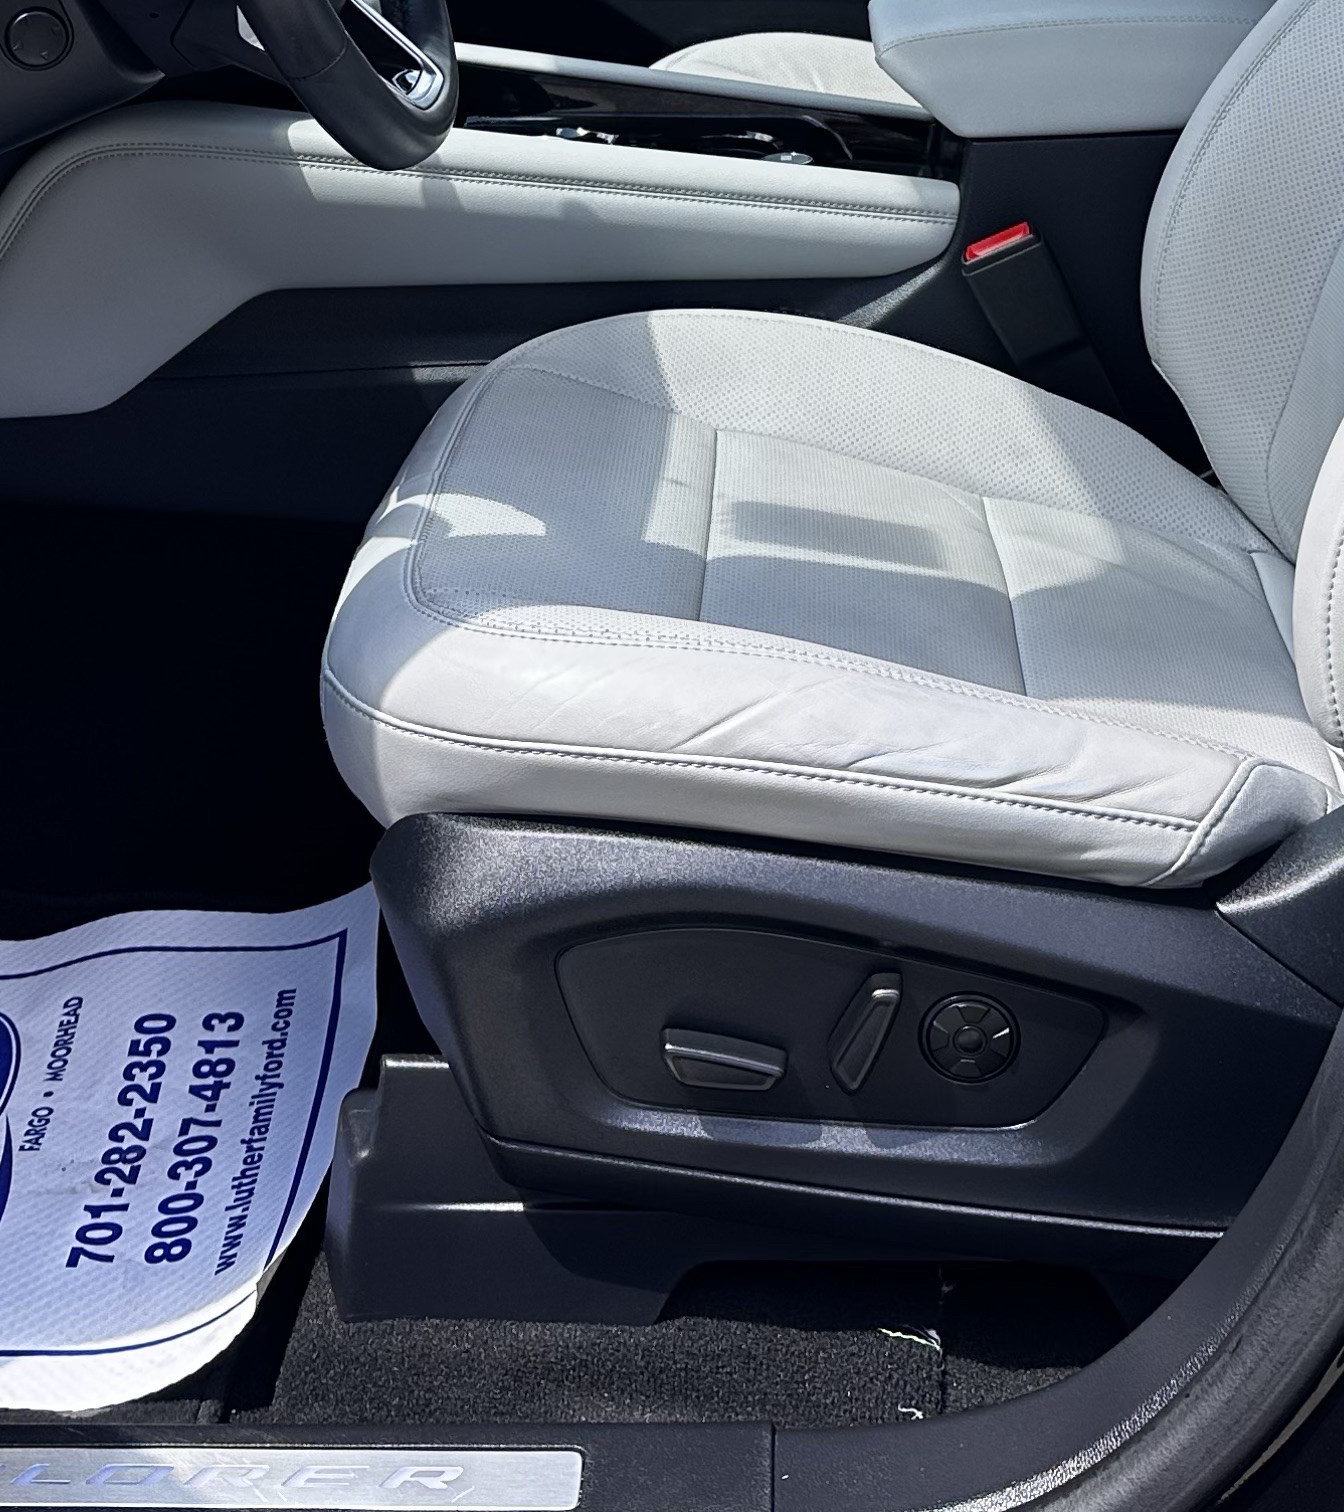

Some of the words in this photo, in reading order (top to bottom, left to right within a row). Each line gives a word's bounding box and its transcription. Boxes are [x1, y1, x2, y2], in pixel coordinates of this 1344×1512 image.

[18, 1106, 54, 1153] FARGO
[45, 996, 83, 1082] MOORHEAD
[65, 1012, 177, 1269] 701-282-2350
[143, 1011, 245, 1265] 800-307-4813
[214, 988, 297, 1277] www.lutherfamilyford.com
